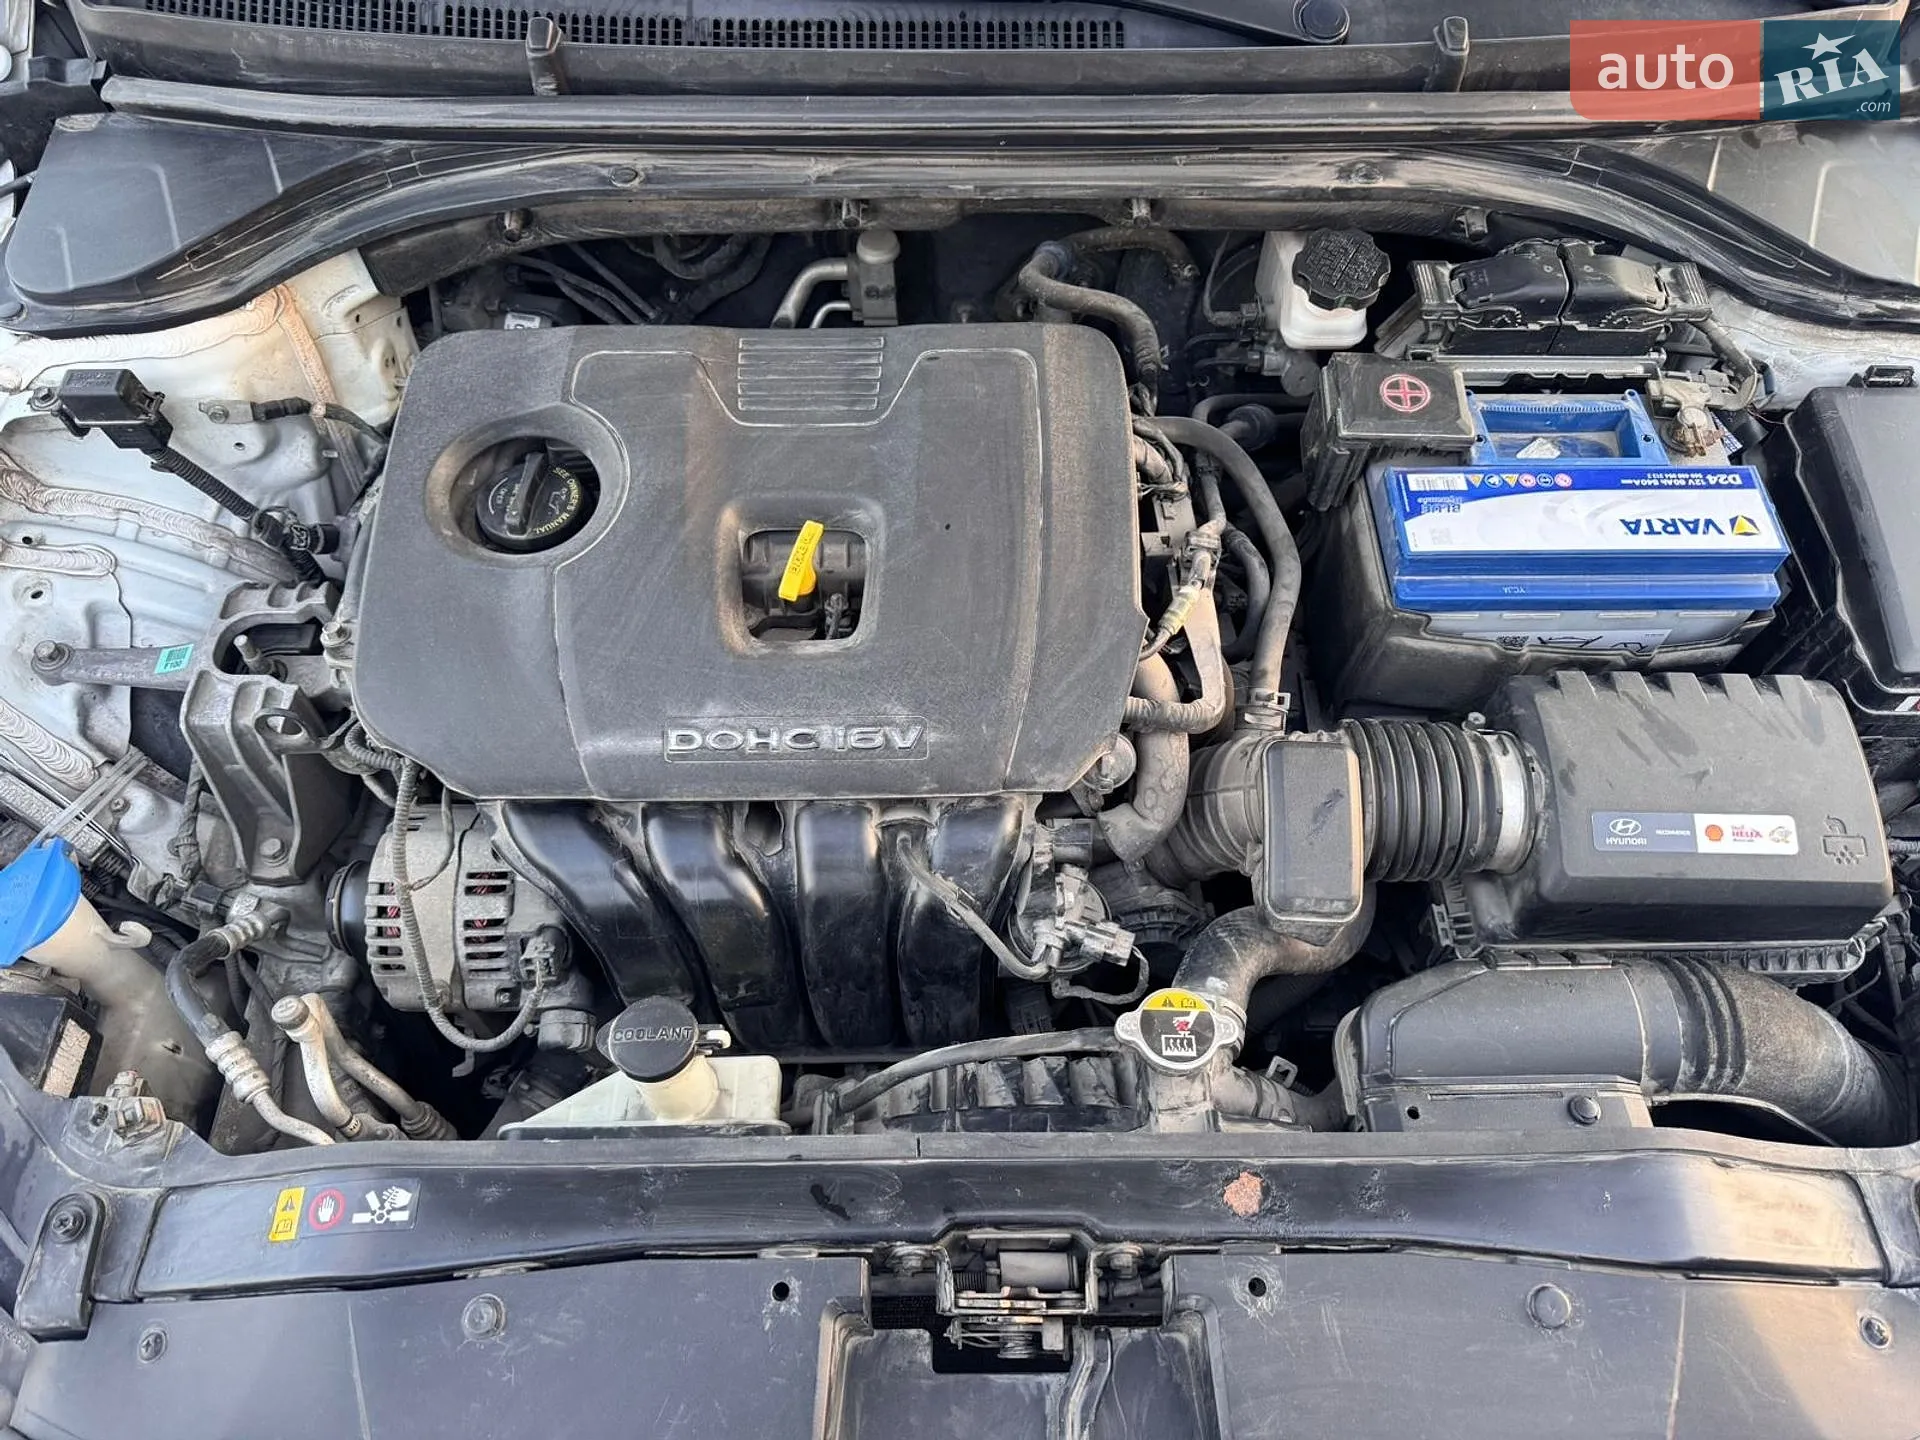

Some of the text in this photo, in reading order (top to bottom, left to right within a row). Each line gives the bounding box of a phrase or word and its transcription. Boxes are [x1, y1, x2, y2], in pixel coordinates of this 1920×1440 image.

[1707, 474, 1743, 485] D24
[533, 512, 570, 534] MANUAL
[1619, 519, 1725, 535] VARTA
[667, 725, 926, 752] DOHC 16V
[1606, 838, 1647, 847] HYUNDAI
[612, 1027, 692, 1042] COOLANT
